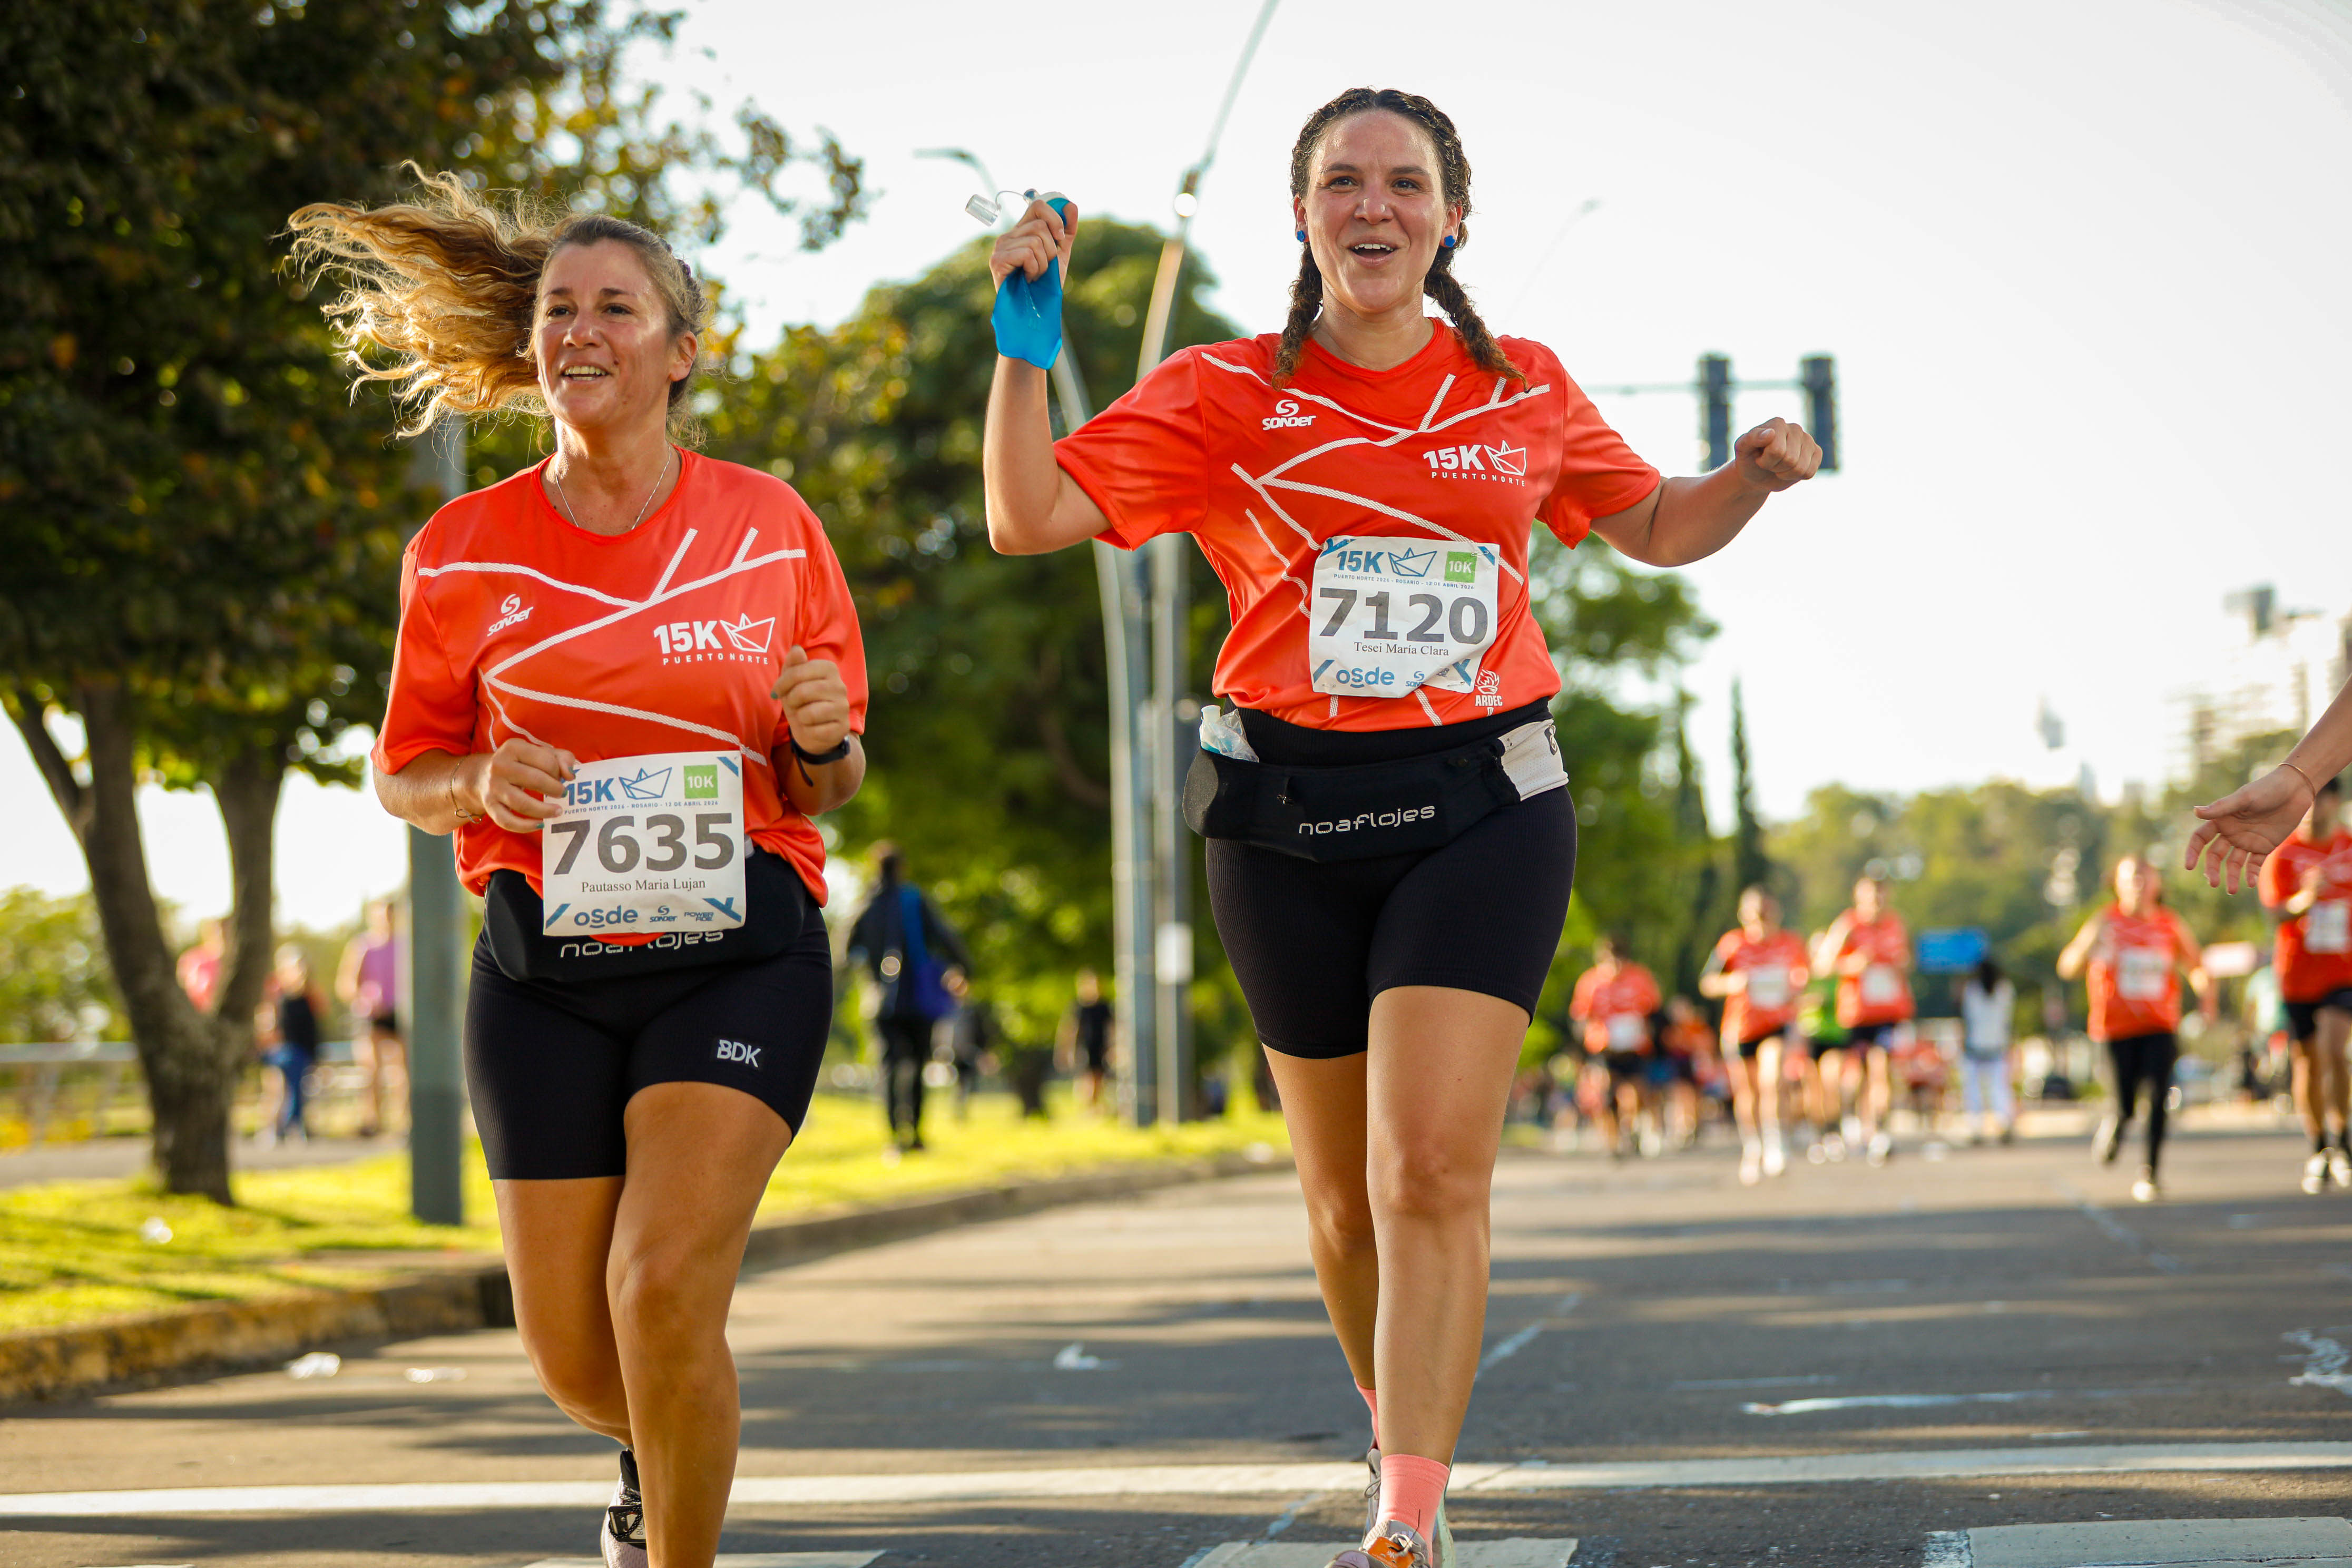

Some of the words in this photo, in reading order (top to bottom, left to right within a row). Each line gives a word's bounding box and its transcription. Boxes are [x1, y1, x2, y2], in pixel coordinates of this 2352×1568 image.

[1423, 444, 1485, 471] 15K
[1337, 551, 1385, 574] 15K
[1449, 560, 1474, 574] 10K
[1319, 587, 1488, 645] 7120
[653, 620, 723, 654] 15K
[1354, 642, 1382, 653] Tesei
[1385, 644, 1417, 654] María
[1420, 645, 1449, 656] Clara
[1336, 667, 1395, 688] osde
[1475, 695, 1503, 706] ARDEC
[566, 777, 615, 806] 15K
[687, 775, 714, 789] 10K
[1299, 805, 1435, 835] noaflojes
[551, 813, 734, 875] 7635
[581, 881, 631, 893] Pautasso
[635, 879, 669, 890] Maria
[673, 878, 705, 891] Lujan
[574, 905, 638, 928] osde
[717, 1039, 761, 1067] BDK
